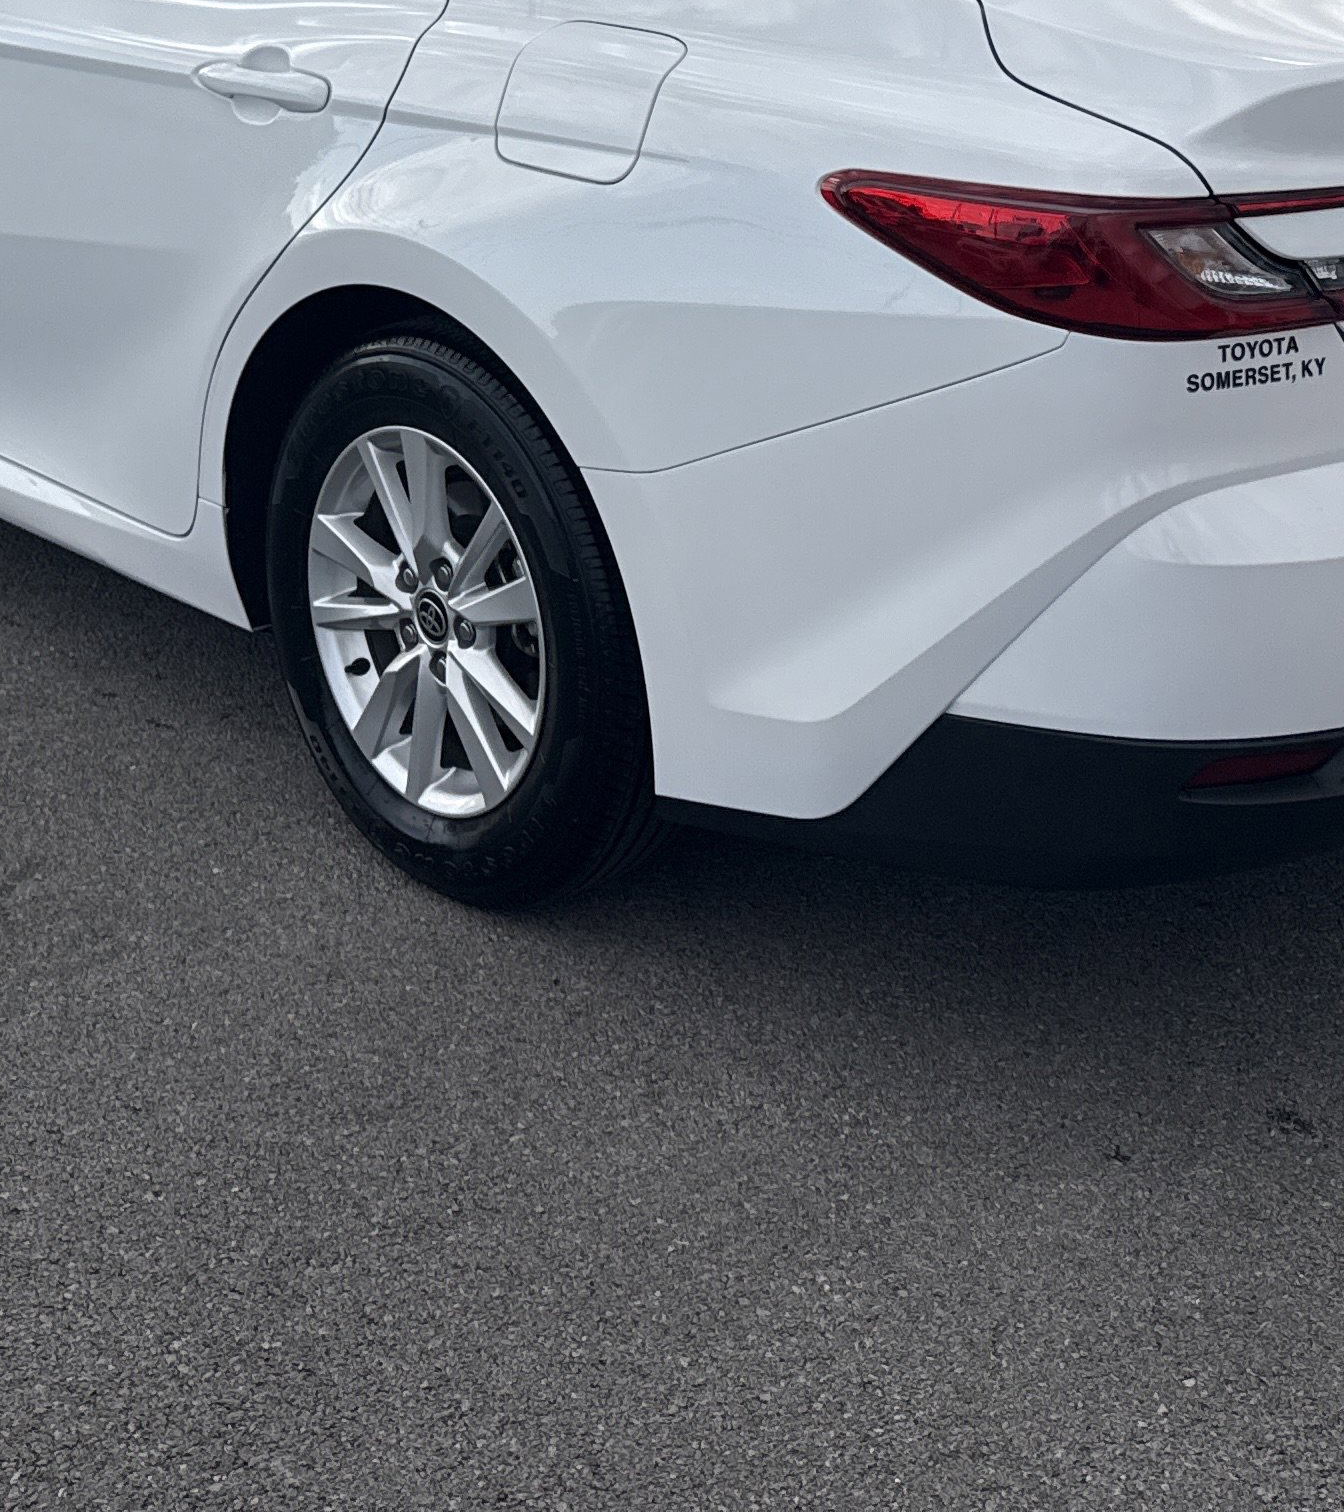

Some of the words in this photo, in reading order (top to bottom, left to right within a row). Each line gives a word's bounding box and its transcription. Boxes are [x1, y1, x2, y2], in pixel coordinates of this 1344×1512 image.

[1218, 336, 1299, 363] TOYOTA
[1186, 362, 1297, 393] SOMERSET,
[1301, 357, 1326, 378] KY
